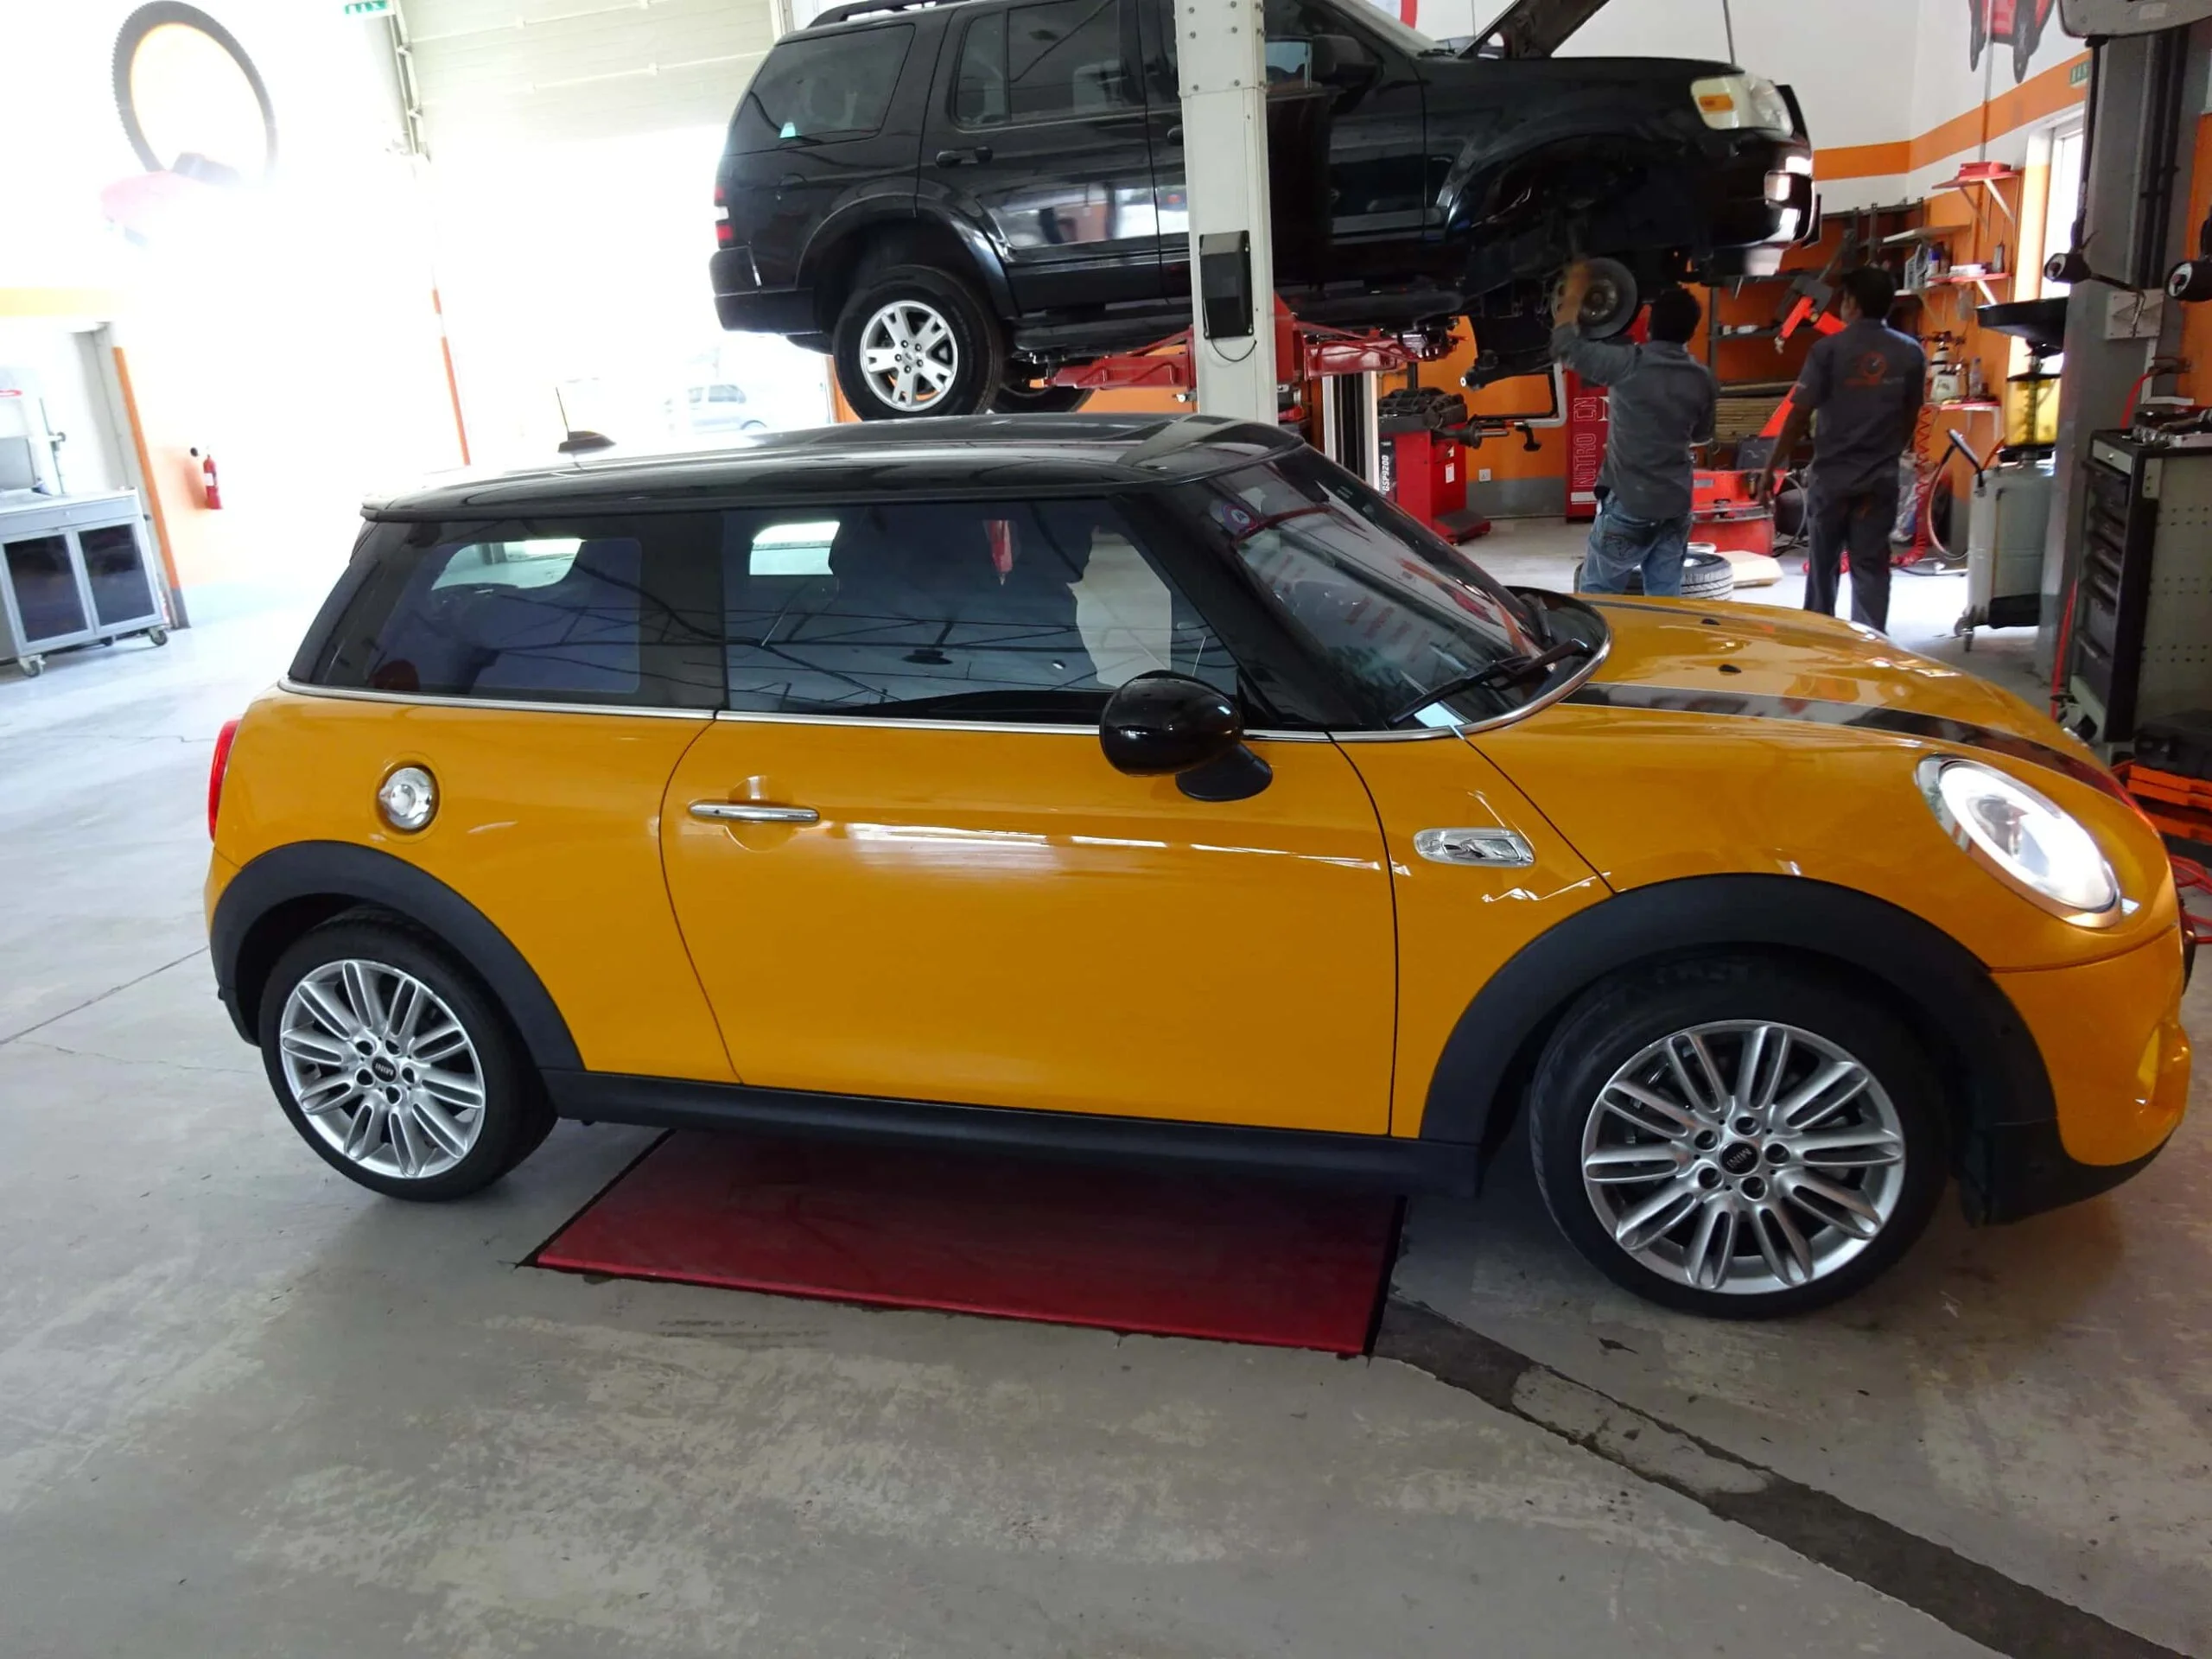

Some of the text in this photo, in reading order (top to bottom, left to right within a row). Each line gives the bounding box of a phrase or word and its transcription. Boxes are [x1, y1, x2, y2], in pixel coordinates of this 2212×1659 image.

[1382, 454, 1390, 493] GSP9200
[1573, 433, 1596, 487] NITRO
[375, 1063, 394, 1077] MINI
[1727, 1147, 1752, 1168] MINI
